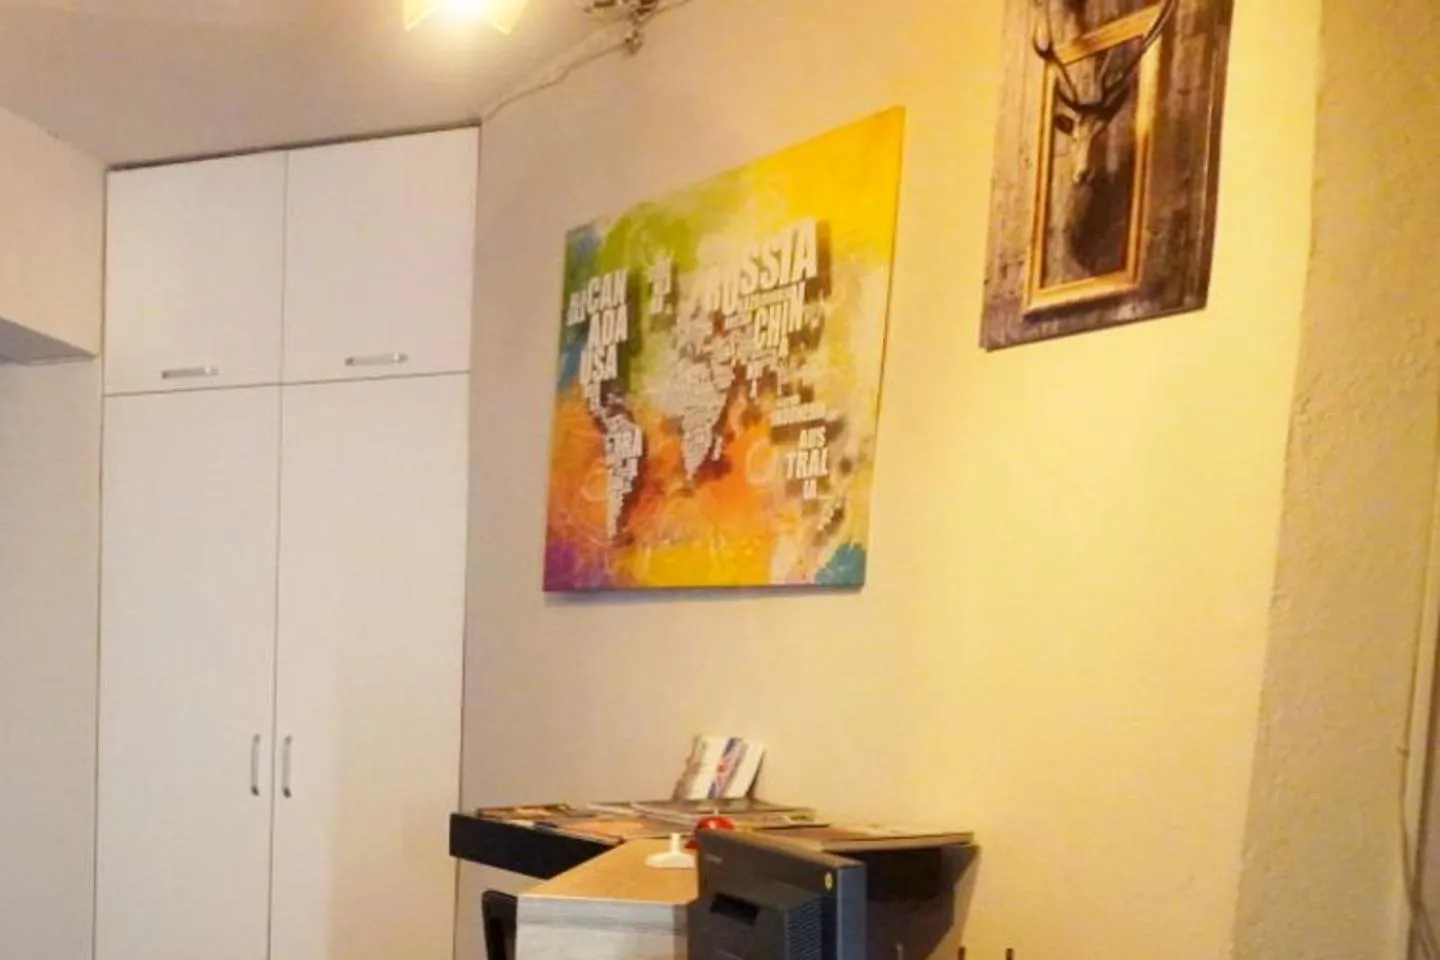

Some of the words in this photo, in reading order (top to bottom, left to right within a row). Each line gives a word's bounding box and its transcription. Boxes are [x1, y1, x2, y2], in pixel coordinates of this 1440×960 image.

[706, 218, 818, 316] RUSSIA
[587, 269, 627, 315] CAN
[588, 303, 627, 351] ADA
[579, 343, 617, 385] USA
[799, 425, 827, 450] AUS
[786, 447, 828, 480] TRAL
